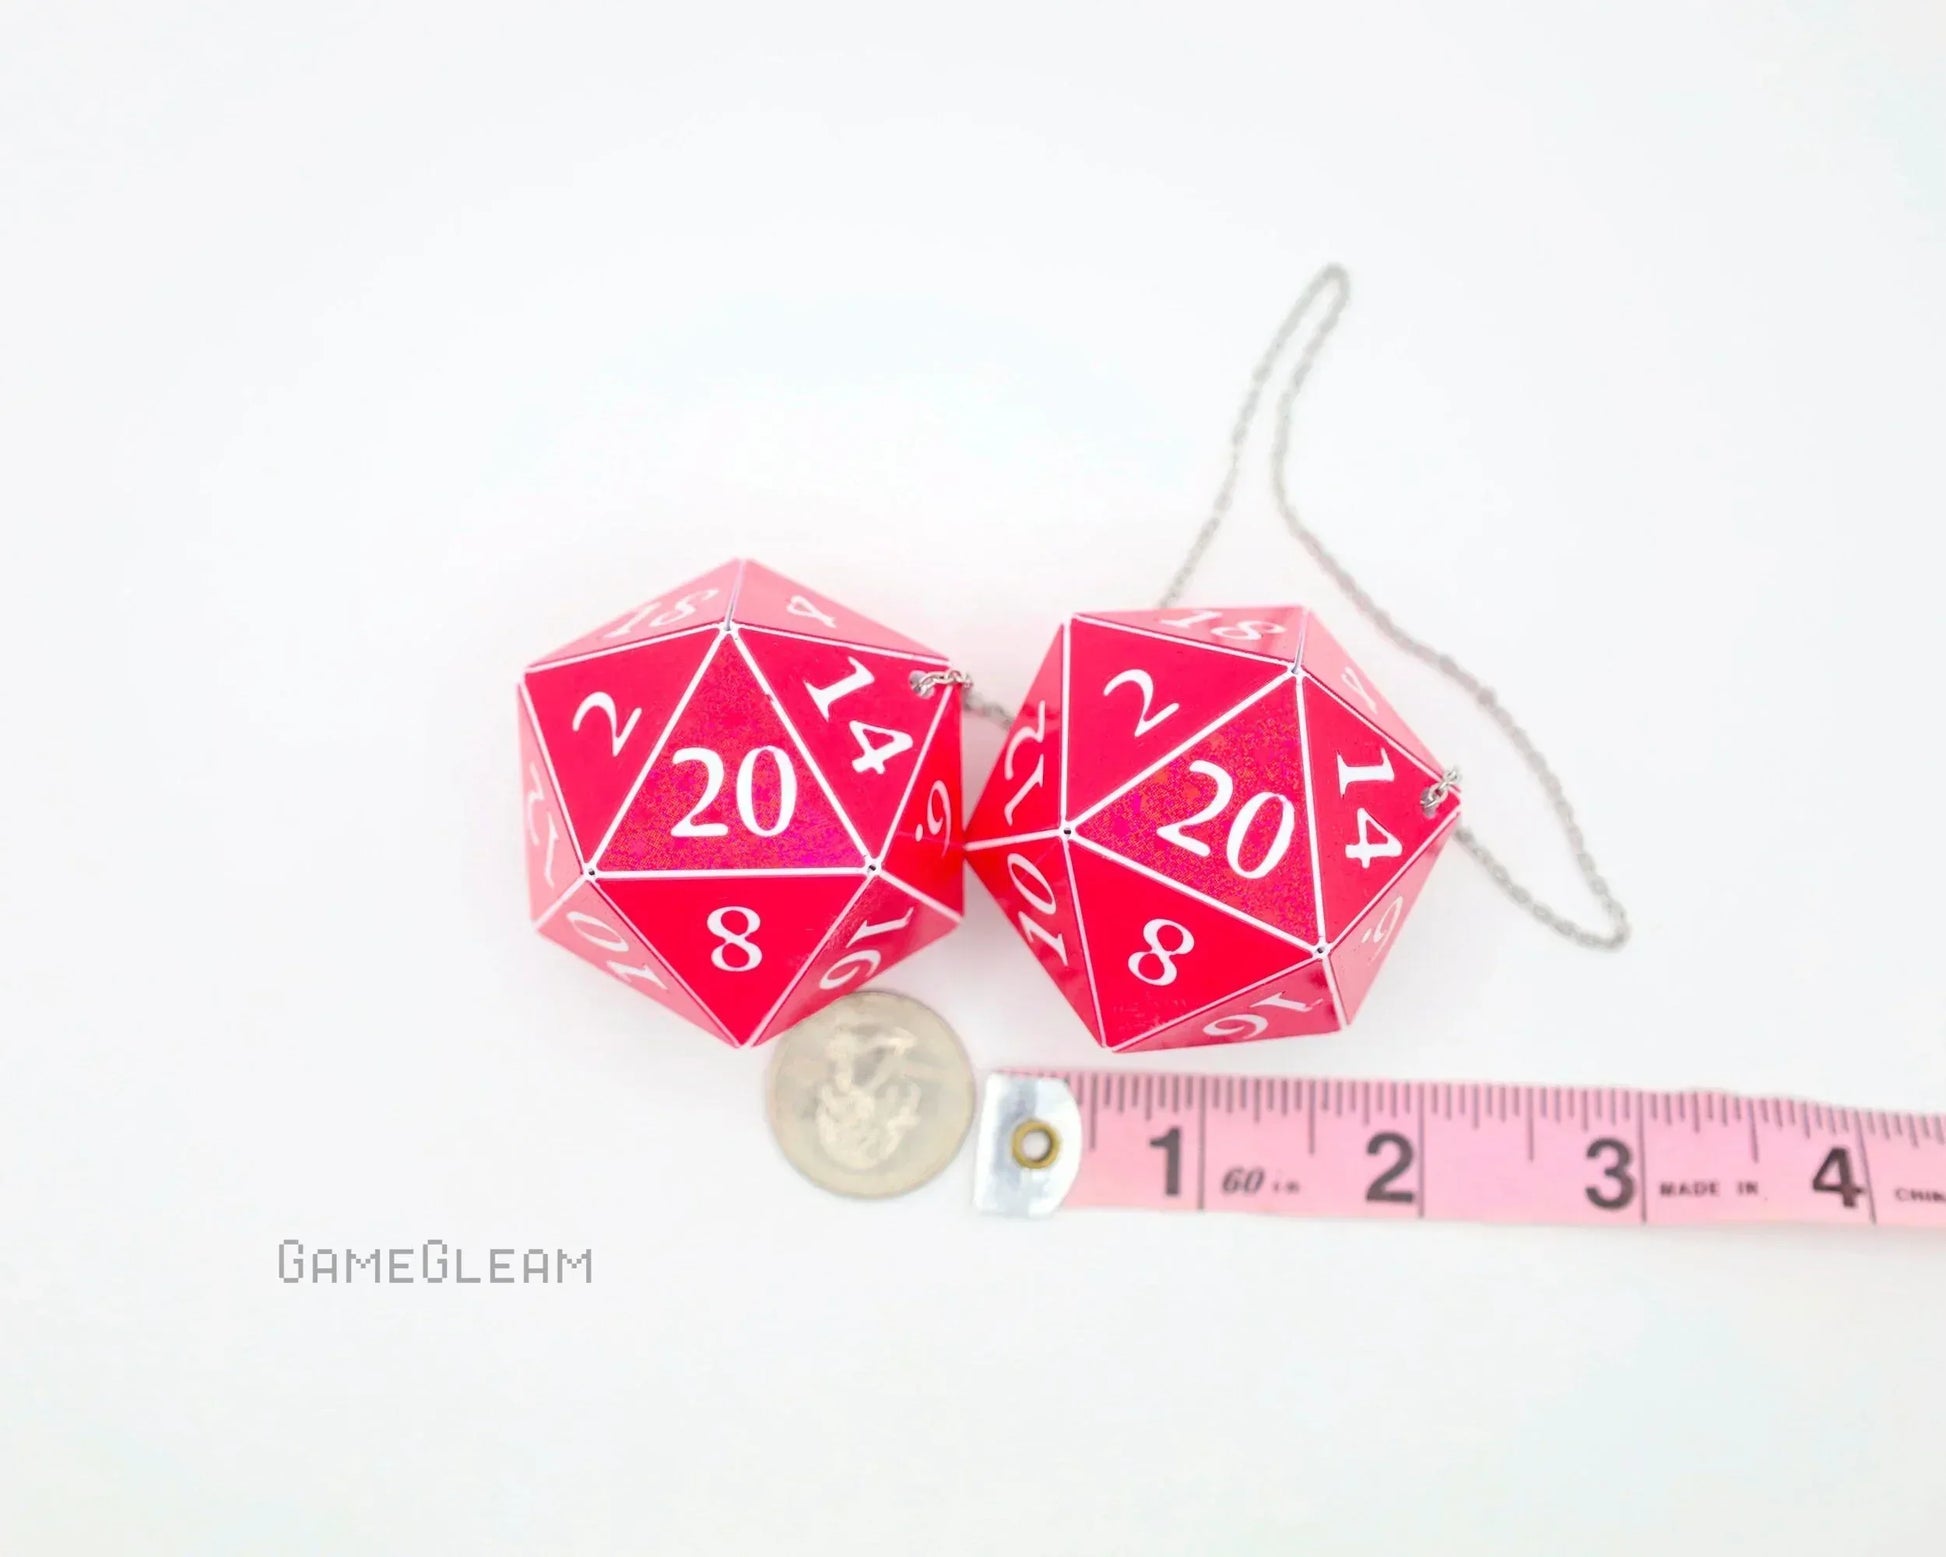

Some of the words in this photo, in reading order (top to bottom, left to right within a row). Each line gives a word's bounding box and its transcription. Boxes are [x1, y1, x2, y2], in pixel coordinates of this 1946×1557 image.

[1158, 609, 1286, 641] 18
[572, 690, 643, 758] 2
[804, 656, 914, 775] 14
[1103, 668, 1180, 738] 2
[670, 745, 799, 838] 20
[1004, 699, 1046, 827] 12
[1156, 760, 1296, 880] 20
[1336, 747, 1403, 870] 14
[706, 906, 764, 972] 8
[1007, 852, 1068, 967] 10
[567, 911, 669, 991] 10
[819, 905, 915, 991] 16
[1128, 917, 1196, 987] 8
[1202, 990, 1324, 1040] 16
[1149, 1125, 1183, 1198] 1
[1221, 1166, 1266, 1196] 60
[1365, 1130, 1416, 1205] 2
[1585, 1137, 1637, 1211] 3
[1659, 1180, 1721, 1199] MADE
[1737, 1181, 1759, 1198] IN
[1811, 1145, 1867, 1209] 4
